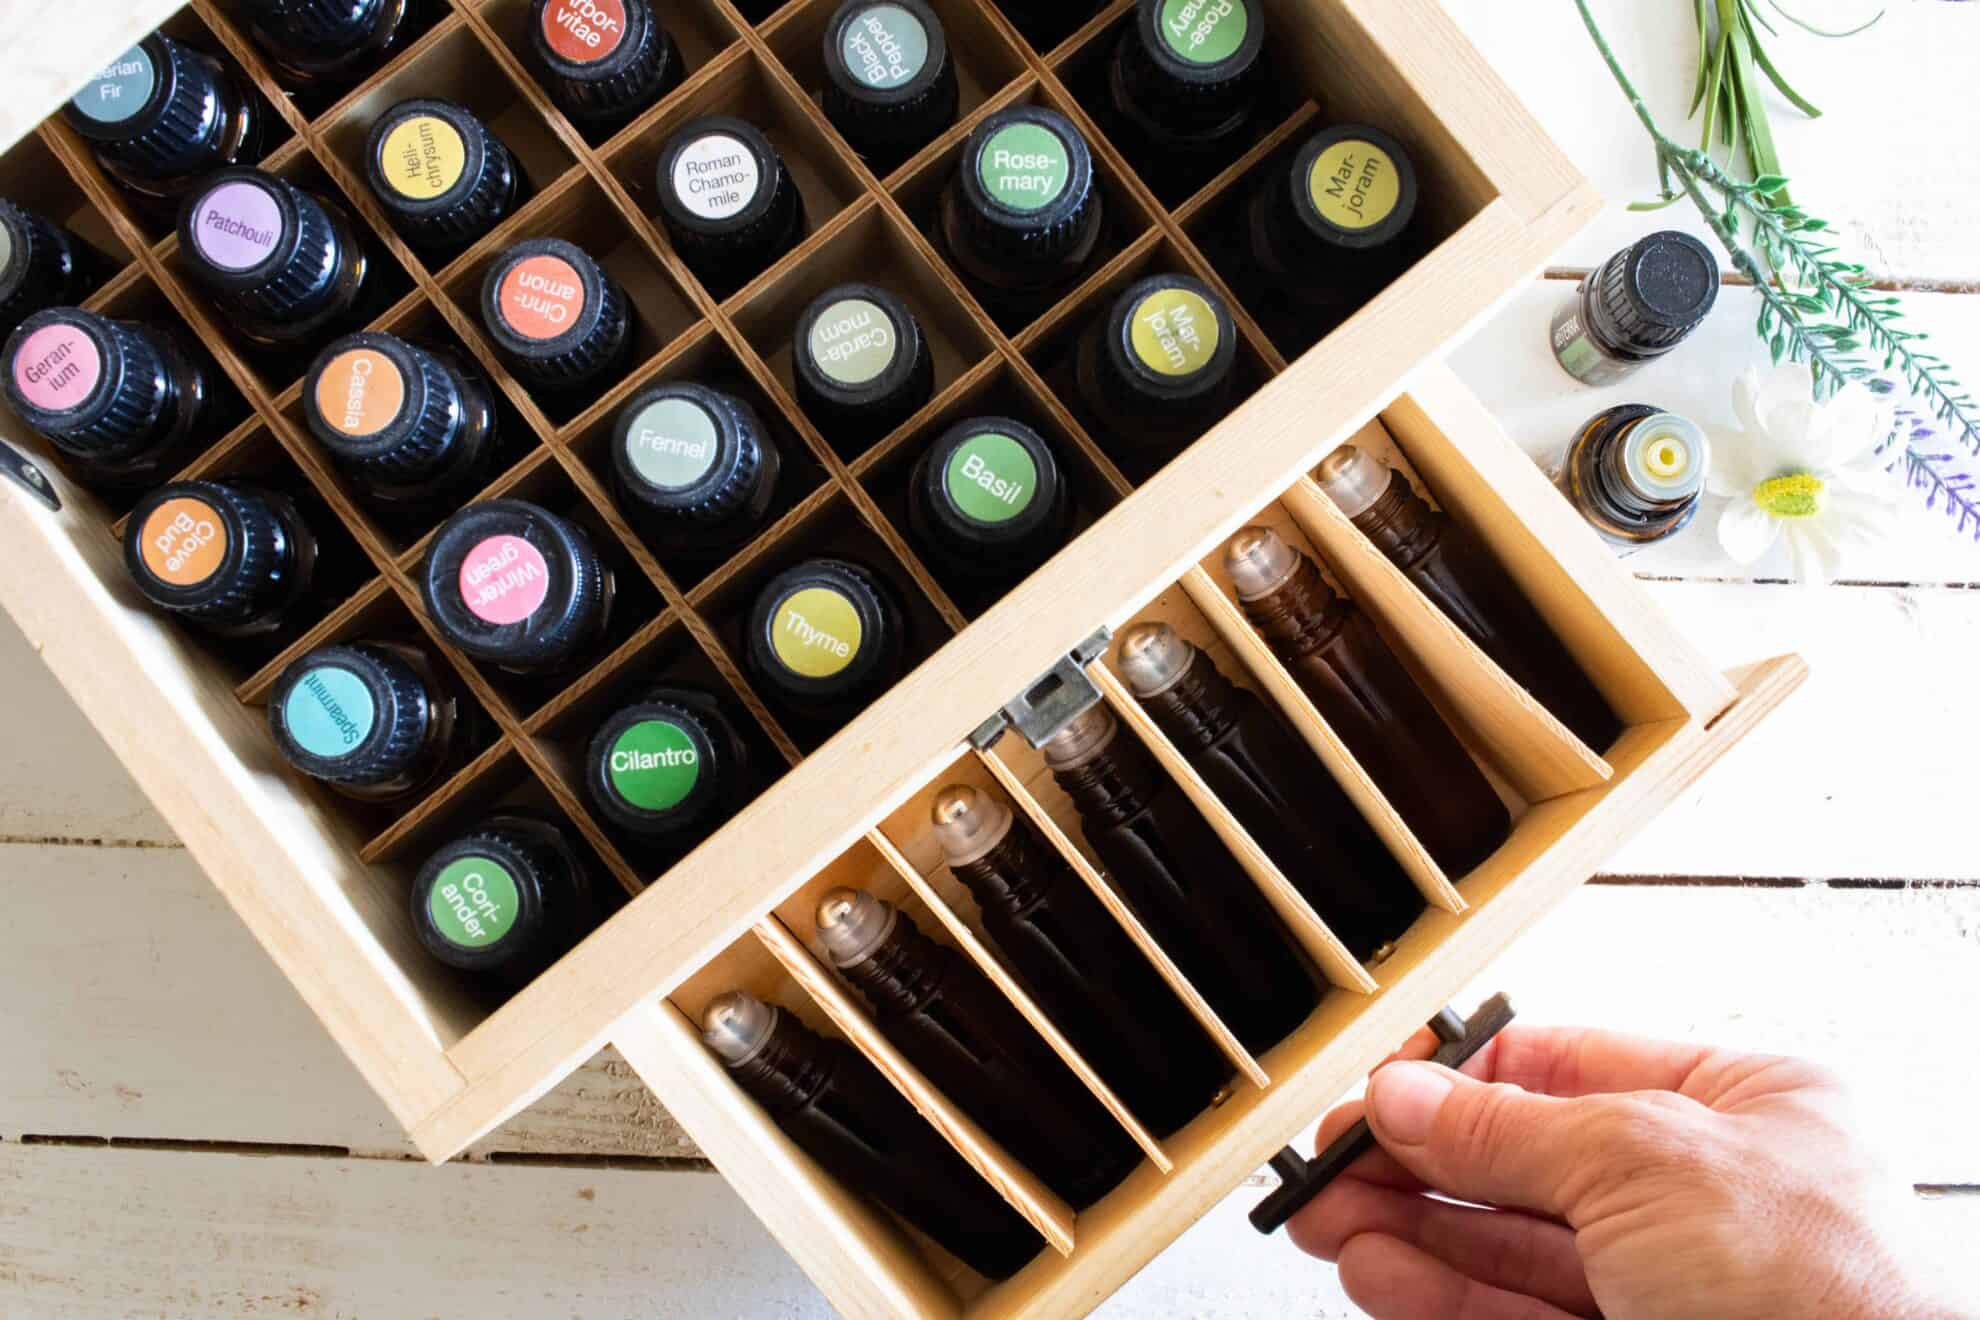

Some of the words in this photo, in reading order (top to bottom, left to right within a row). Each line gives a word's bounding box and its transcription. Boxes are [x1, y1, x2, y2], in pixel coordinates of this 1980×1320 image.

[556, 7, 601, 48] vitae
[863, 15, 909, 79] Pepper
[1189, 0, 1232, 51] Rose-
[96, 60, 143, 80] erian
[850, 31, 888, 83] Black
[100, 83, 122, 101] Fir
[407, 143, 420, 178] Heli-
[419, 122, 442, 188] chrysum
[686, 153, 741, 176] Roman
[994, 149, 1057, 170] Rose-
[1325, 154, 1355, 199] Mar-
[688, 171, 750, 194] Chamo-
[708, 190, 740, 209] mile
[999, 173, 1053, 196] mary
[1347, 157, 1379, 219] joram
[205, 210, 274, 248] Patchouli
[518, 271, 576, 301] amon
[514, 294, 567, 323] Cinn-
[819, 310, 871, 342] mom
[1171, 303, 1200, 352] Mar-
[821, 327, 888, 363] Carda-
[1143, 309, 1186, 369] joram
[24, 341, 73, 384] Geran-
[50, 361, 81, 391] ium
[343, 358, 373, 429] Cassia
[639, 429, 707, 459] Fennel
[960, 453, 1023, 505] Basil
[155, 511, 194, 555] Bud
[166, 520, 216, 573] Clove
[464, 541, 520, 586] green
[786, 610, 850, 658] Thyme
[303, 673, 360, 744] Spearmint
[609, 748, 697, 772] Cilantro
[441, 884, 486, 938] ander
[462, 873, 500, 923] Cori-
